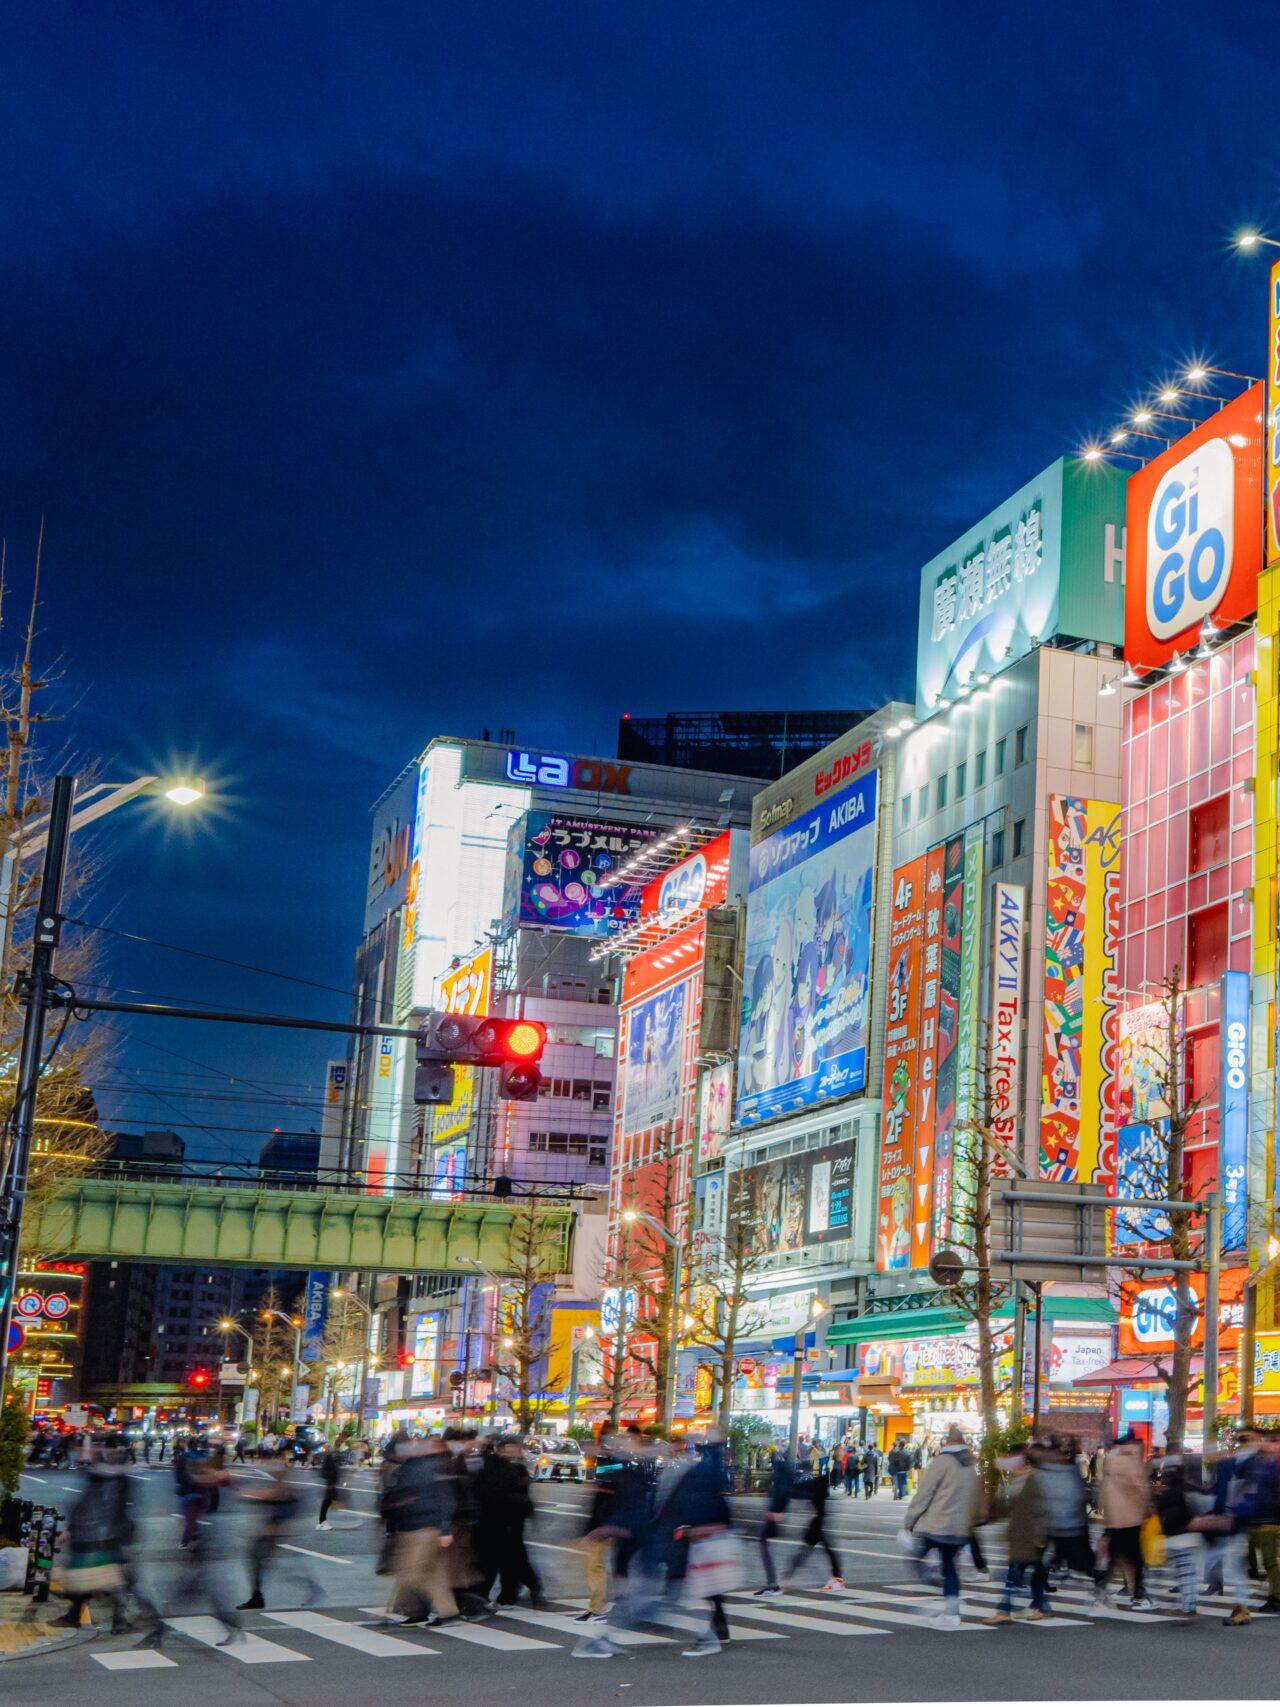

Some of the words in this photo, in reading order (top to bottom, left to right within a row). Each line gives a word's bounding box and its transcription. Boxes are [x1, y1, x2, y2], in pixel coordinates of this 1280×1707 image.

[1152, 527, 1226, 624] GO
[814, 740, 873, 797] ビックカメラ
[760, 797, 793, 831] Sofmap
[771, 816, 821, 866] ソフマップ
[828, 792, 866, 834] AKIBA
[894, 877, 913, 910] 4F
[999, 890, 1020, 973] AKKY
[890, 987, 907, 1022] 3F
[993, 997, 1018, 1112] Tax-free
[884, 1108, 903, 1145] 2F
[50, 1300, 65, 1312] 50
[310, 1280, 322, 1322] AKIBA
